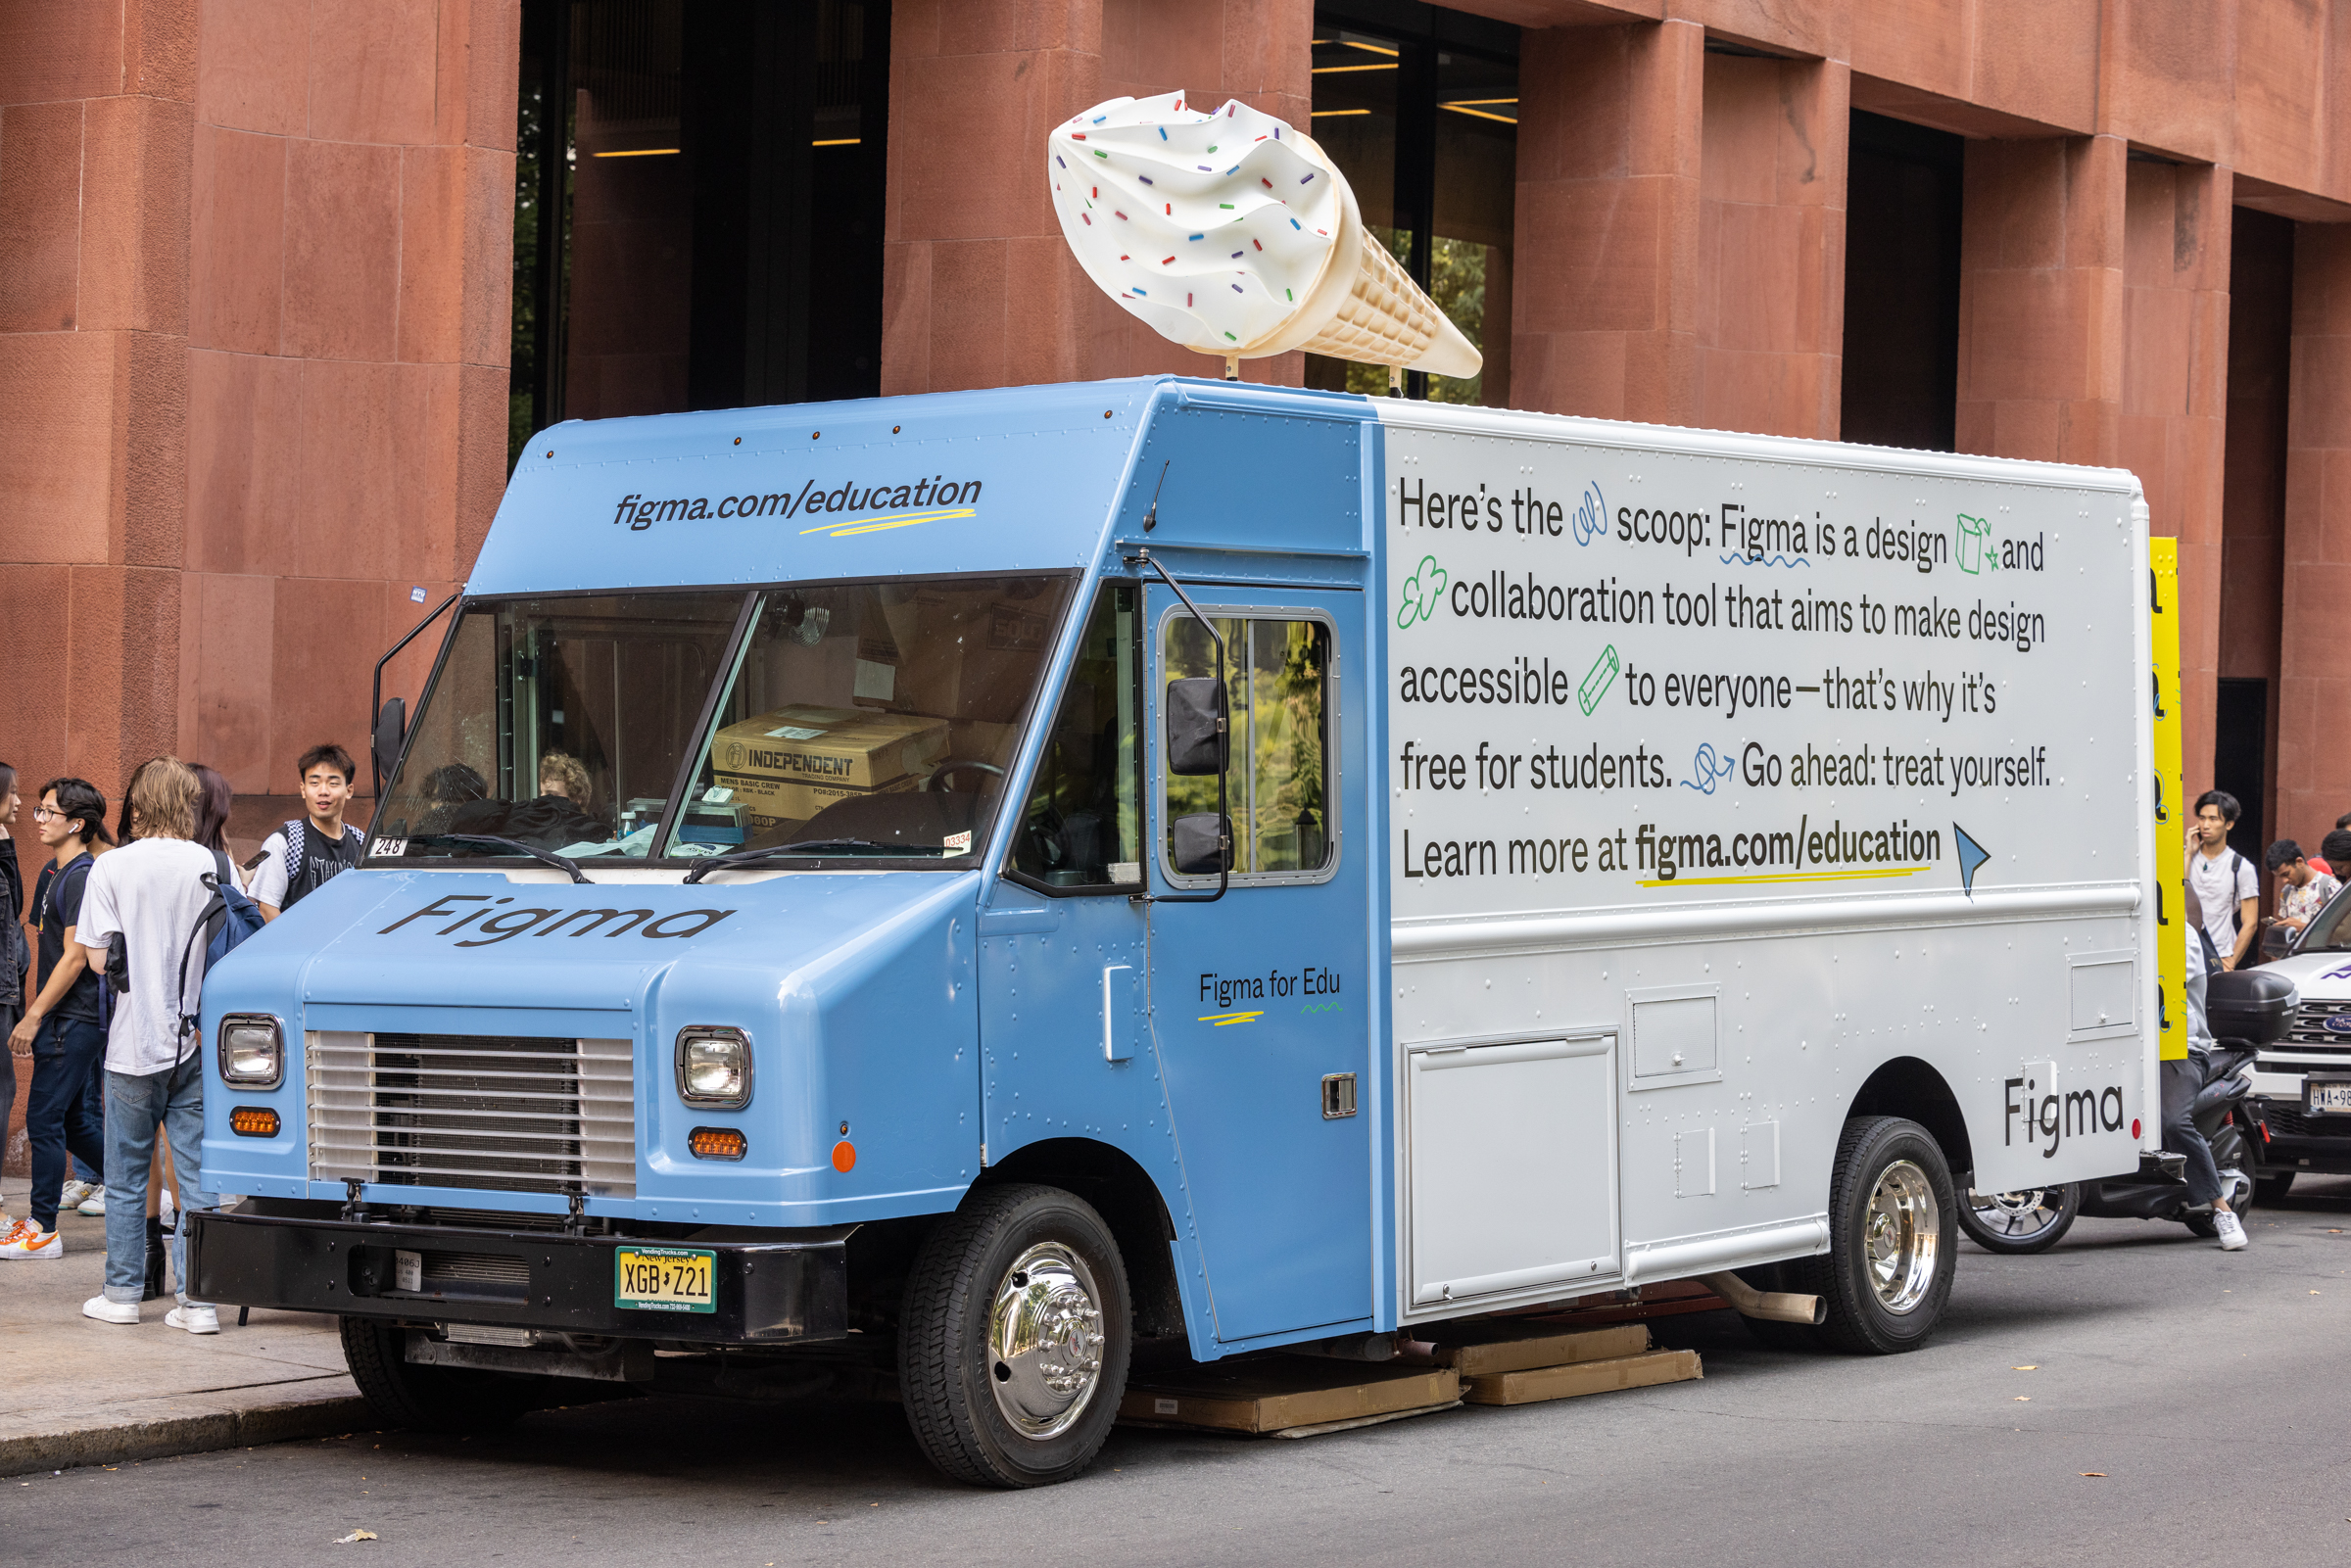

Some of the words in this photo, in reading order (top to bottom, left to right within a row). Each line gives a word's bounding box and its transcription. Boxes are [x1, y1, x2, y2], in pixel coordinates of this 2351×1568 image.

[613, 475, 983, 531] figma.com/education
[1400, 476, 1503, 533] Here's
[1511, 487, 1563, 537] the
[1616, 506, 1710, 557] scoop:
[1721, 502, 1808, 562] Figma
[1816, 511, 1836, 556] is
[1844, 525, 1859, 557] a
[1866, 516, 1946, 574] design
[2002, 531, 2043, 572] and
[1451, 569, 1654, 624] collaboration
[1662, 582, 1716, 627] tool
[1724, 584, 1784, 630] that
[1791, 588, 1853, 634] aims
[1859, 594, 1886, 635] to
[1895, 595, 1961, 639] make
[1968, 598, 2044, 653] design
[1400, 656, 1568, 705] accessible
[1624, 662, 1655, 707] to
[1902, 669, 1955, 723] why
[1962, 671, 1996, 714] it's
[720, 777, 740, 785] MENS
[740, 779, 760, 787] BASIC
[748, 749, 853, 777] INDEPENDENT
[1400, 740, 1466, 790] free
[1475, 741, 1522, 790] for
[1530, 741, 1672, 790] students.
[1742, 741, 1782, 787] Go
[1790, 742, 1876, 786] ahead:
[1883, 746, 1944, 786] treat
[1949, 745, 2050, 797] yourself.
[375, 838, 402, 855] 248
[945, 832, 971, 848] 03334
[1404, 829, 1497, 879] Learn
[1509, 837, 1589, 875] more
[1598, 828, 1628, 872] at
[1635, 814, 1941, 881] figma.com/education
[377, 894, 737, 948] Figma
[1200, 974, 1265, 1008] Figma
[1269, 970, 1298, 997] for
[1304, 967, 1340, 995] Edu
[2004, 1077, 2124, 1159] Figma
[642, 1248, 689, 1257] VendingTrucks.com
[625, 1263, 659, 1294] XGB
[673, 1265, 708, 1297] Z21
